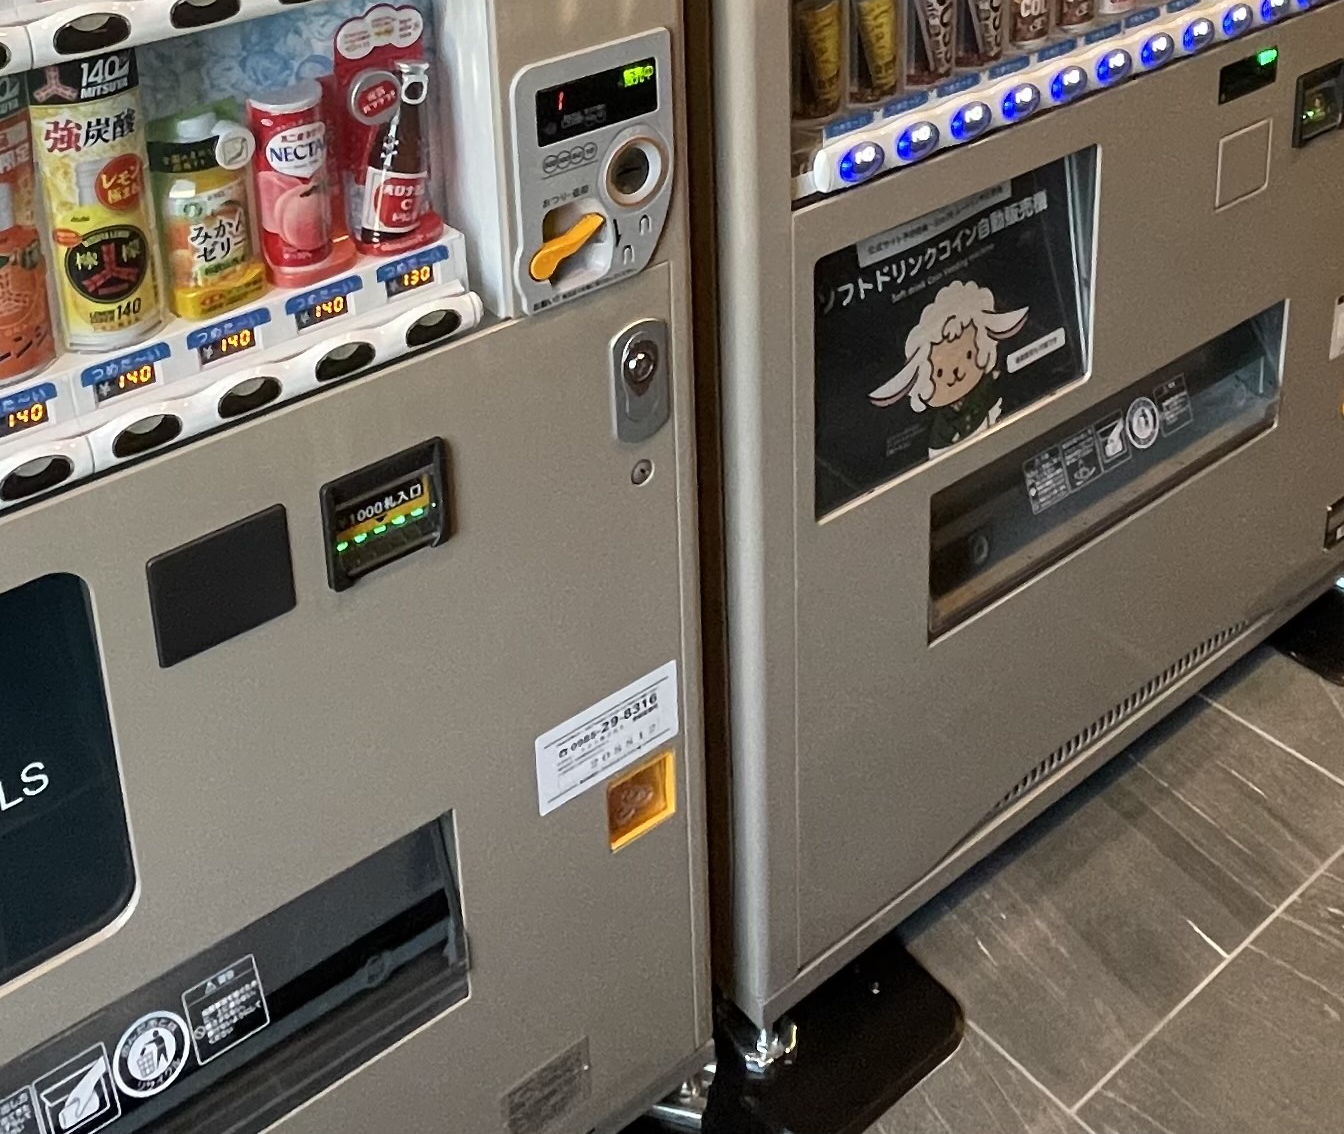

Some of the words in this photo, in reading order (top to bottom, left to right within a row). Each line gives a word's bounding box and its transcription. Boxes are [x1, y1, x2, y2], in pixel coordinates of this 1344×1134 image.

[79, 78, 130, 100] MITSUYA
[44, 107, 137, 154] 強炭酸
[196, 236, 248, 263] ゼリー
[401, 266, 430, 286] 130
[315, 297, 344, 317] 140
[221, 330, 251, 352] 140
[118, 365, 153, 388] 140
[9, 405, 44, 427] 140
